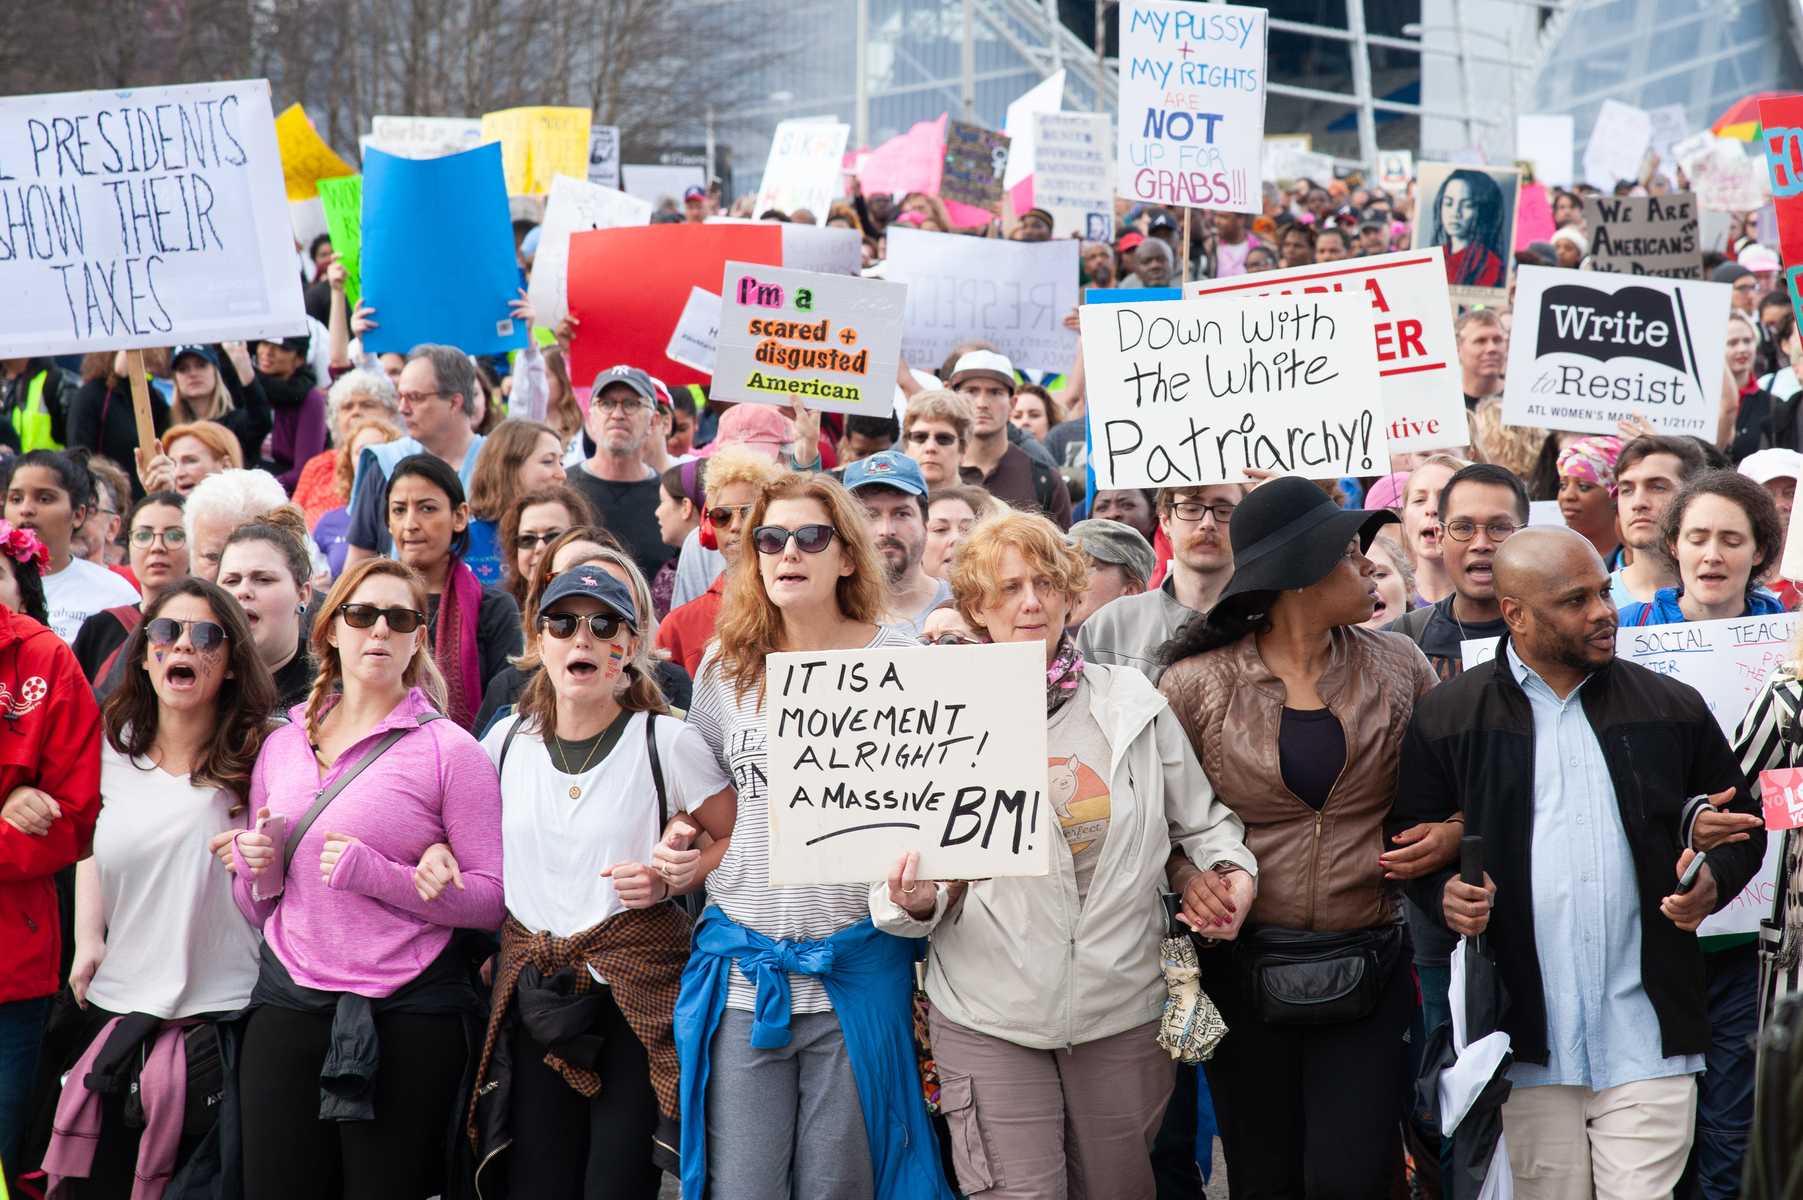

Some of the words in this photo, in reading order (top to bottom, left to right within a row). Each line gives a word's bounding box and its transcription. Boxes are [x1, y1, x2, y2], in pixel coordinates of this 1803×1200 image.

[1131, 9, 1170, 43] MY
[1175, 10, 1255, 50] PUSSY
[1131, 57, 1173, 91] MY
[1180, 61, 1257, 92] RIGHTS
[1164, 91, 1199, 111] ARE
[28, 95, 248, 178] PRESIDENTS
[1143, 107, 1224, 144] NOT
[1130, 142, 1166, 167] UP
[1179, 145, 1228, 175] FOR
[1134, 168, 1248, 206] GRABS!!!
[103, 173, 224, 255] THEIR
[50, 255, 173, 340] TAXES
[740, 278, 781, 306] I'm
[795, 287, 812, 310] a
[750, 319, 828, 342] scared
[841, 329, 856, 344] +
[1117, 309, 1222, 353] Down
[1549, 303, 1670, 348] Write
[755, 341, 867, 374] disgusted
[747, 372, 860, 400] American
[1123, 361, 1191, 408] the
[1530, 371, 1557, 395] to
[1555, 365, 1686, 405] Resist
[1527, 404, 1547, 416] ATL
[1551, 406, 1604, 421] WOMEN'S
[1662, 416, 1706, 430] 1/21/17
[1104, 409, 1373, 487] Patriarchy!
[1634, 628, 1713, 654] SOCIAL
[783, 660, 827, 697] IT
[837, 662, 869, 693] IS
[879, 661, 904, 692] A
[778, 700, 966, 738] MOVEMENT
[793, 731, 990, 772] ALRIGHT!
[789, 785, 814, 809] A
[821, 781, 946, 812] MASSIVE
[940, 786, 1041, 855] BM!
